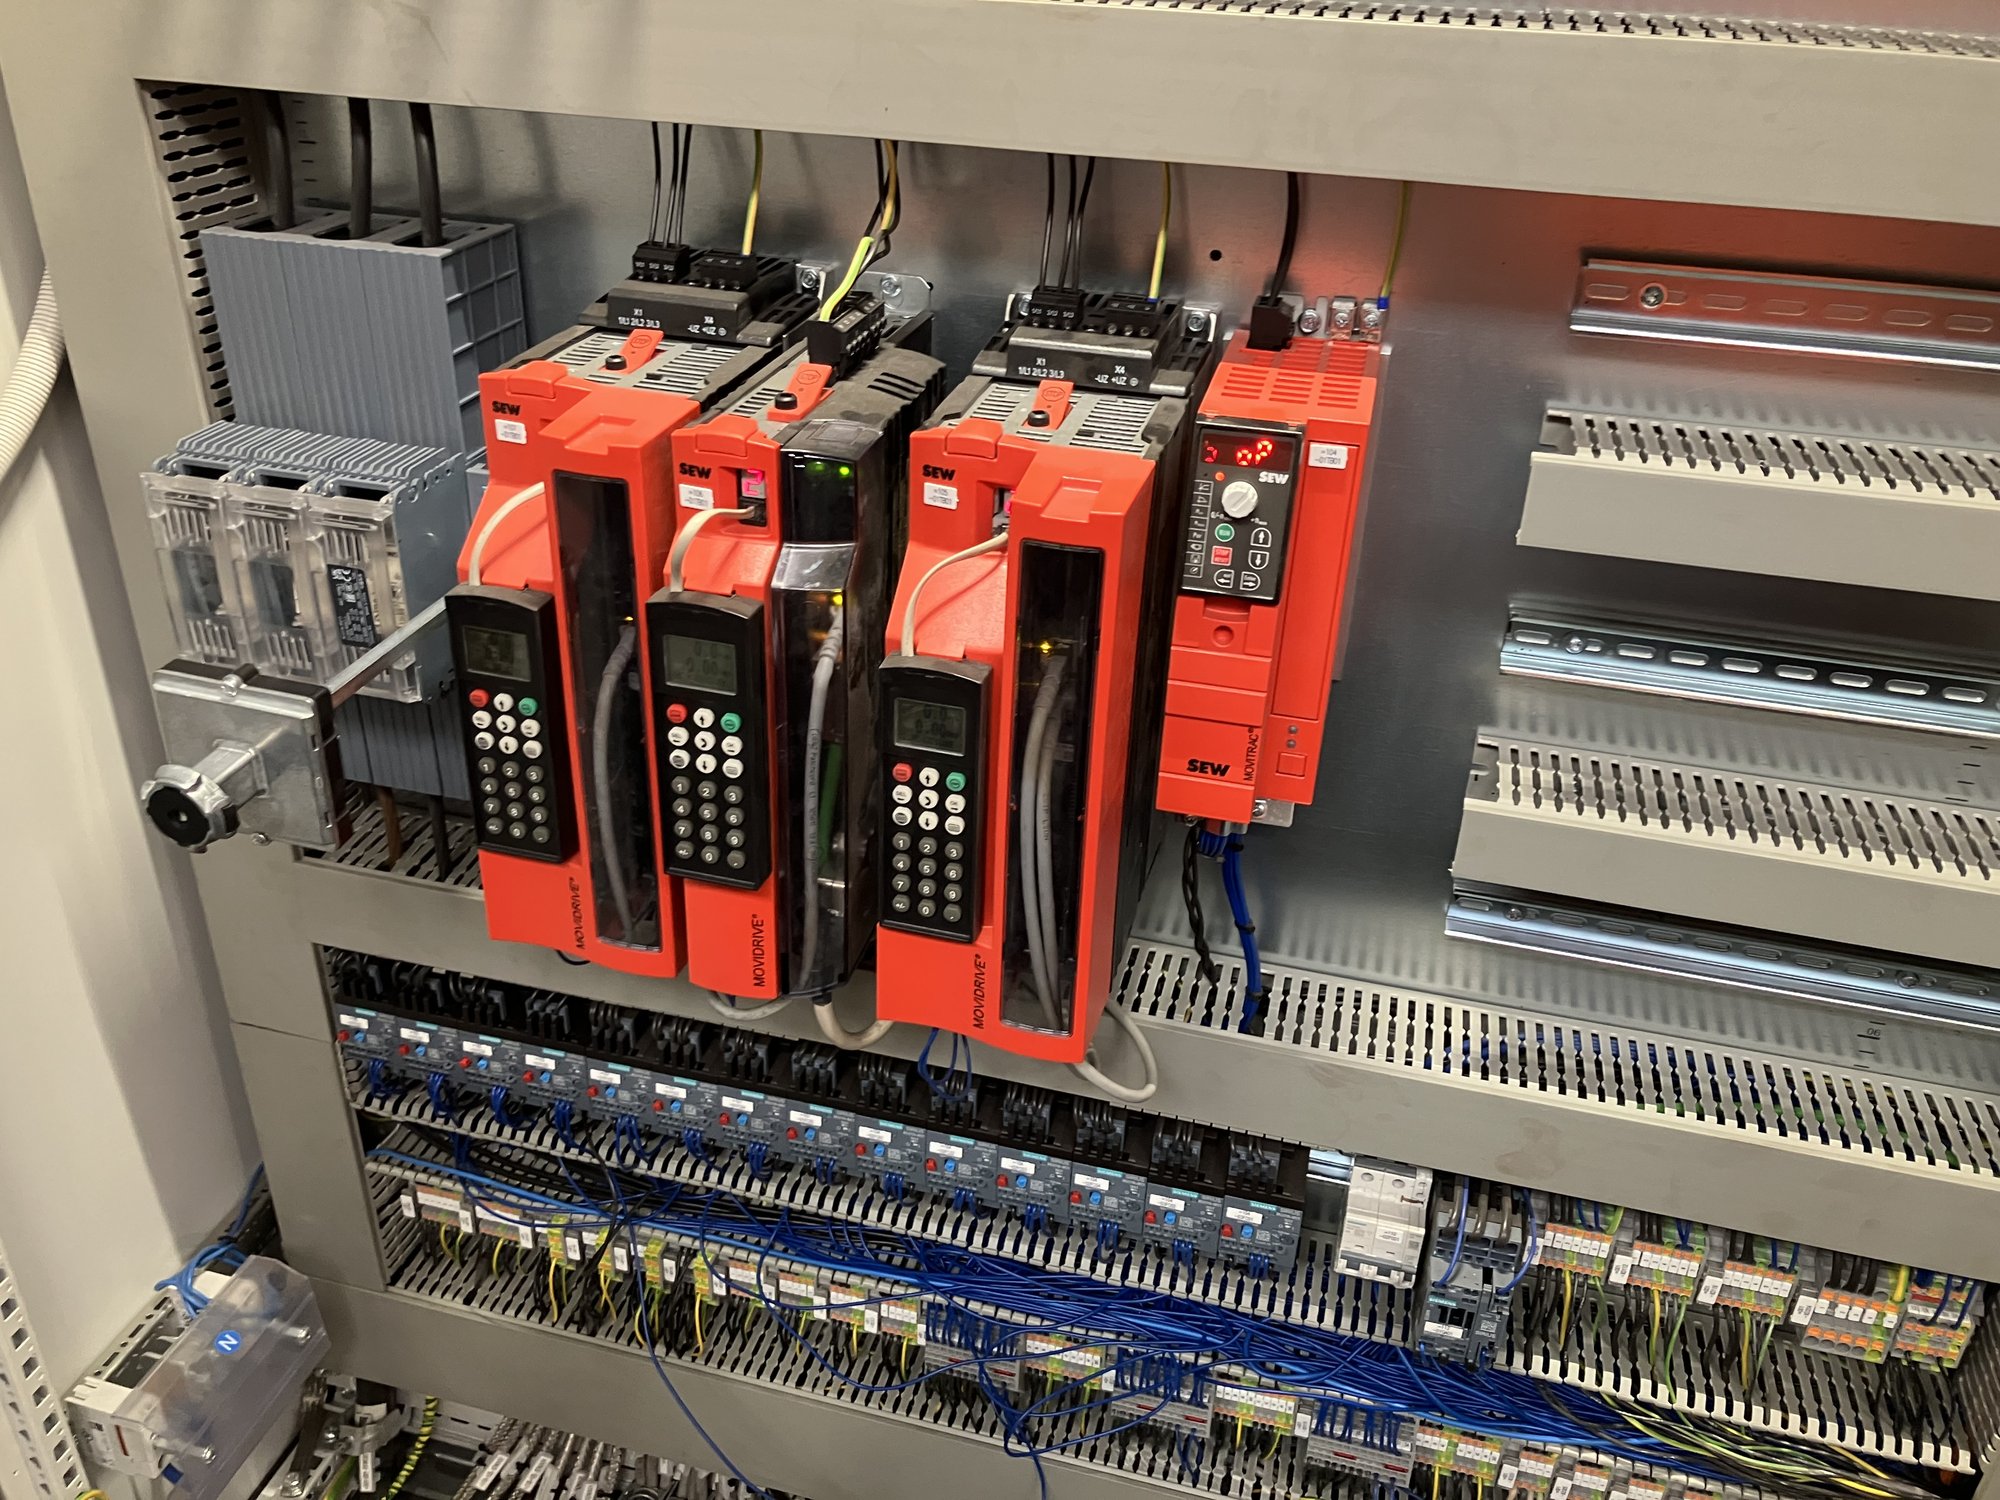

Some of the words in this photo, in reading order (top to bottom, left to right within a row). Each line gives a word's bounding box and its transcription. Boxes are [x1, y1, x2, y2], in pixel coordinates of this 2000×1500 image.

[1036, 357, 1046, 366] X1
[1032, 367, 1048, 378] 2/L2
[1048, 368, 1065, 379] 3/L3
[1114, 365, 1126, 374] X4
[1094, 375, 1109, 384] -UZ
[1111, 376, 1127, 387] +UZ
[492, 400, 521, 416] SEW
[679, 462, 712, 480] SEW
[922, 464, 956, 481] SEW
[1258, 471, 1290, 485] SEW
[1186, 758, 1231, 777] SEW
[677, 783, 682, 792] 1
[702, 788, 710, 797] 2
[729, 792, 737, 801] 3
[677, 805, 684, 813] 4
[703, 810, 711, 818] 5
[730, 814, 738, 823] 6
[678, 826, 686, 835] 7
[704, 831, 712, 840] 8
[730, 836, 738, 845] 9
[898, 840, 903, 848] 1
[923, 844, 931, 853] 2
[950, 848, 957, 858] 3
[705, 852, 713, 861] 0
[923, 865, 930, 873] 5
[949, 870, 957, 878] 6
[897, 881, 904, 889] 7
[922, 886, 930, 894] 8
[949, 890, 956, 899] 9
[922, 906, 930, 915] 0
[217, 1333, 239, 1351] N
